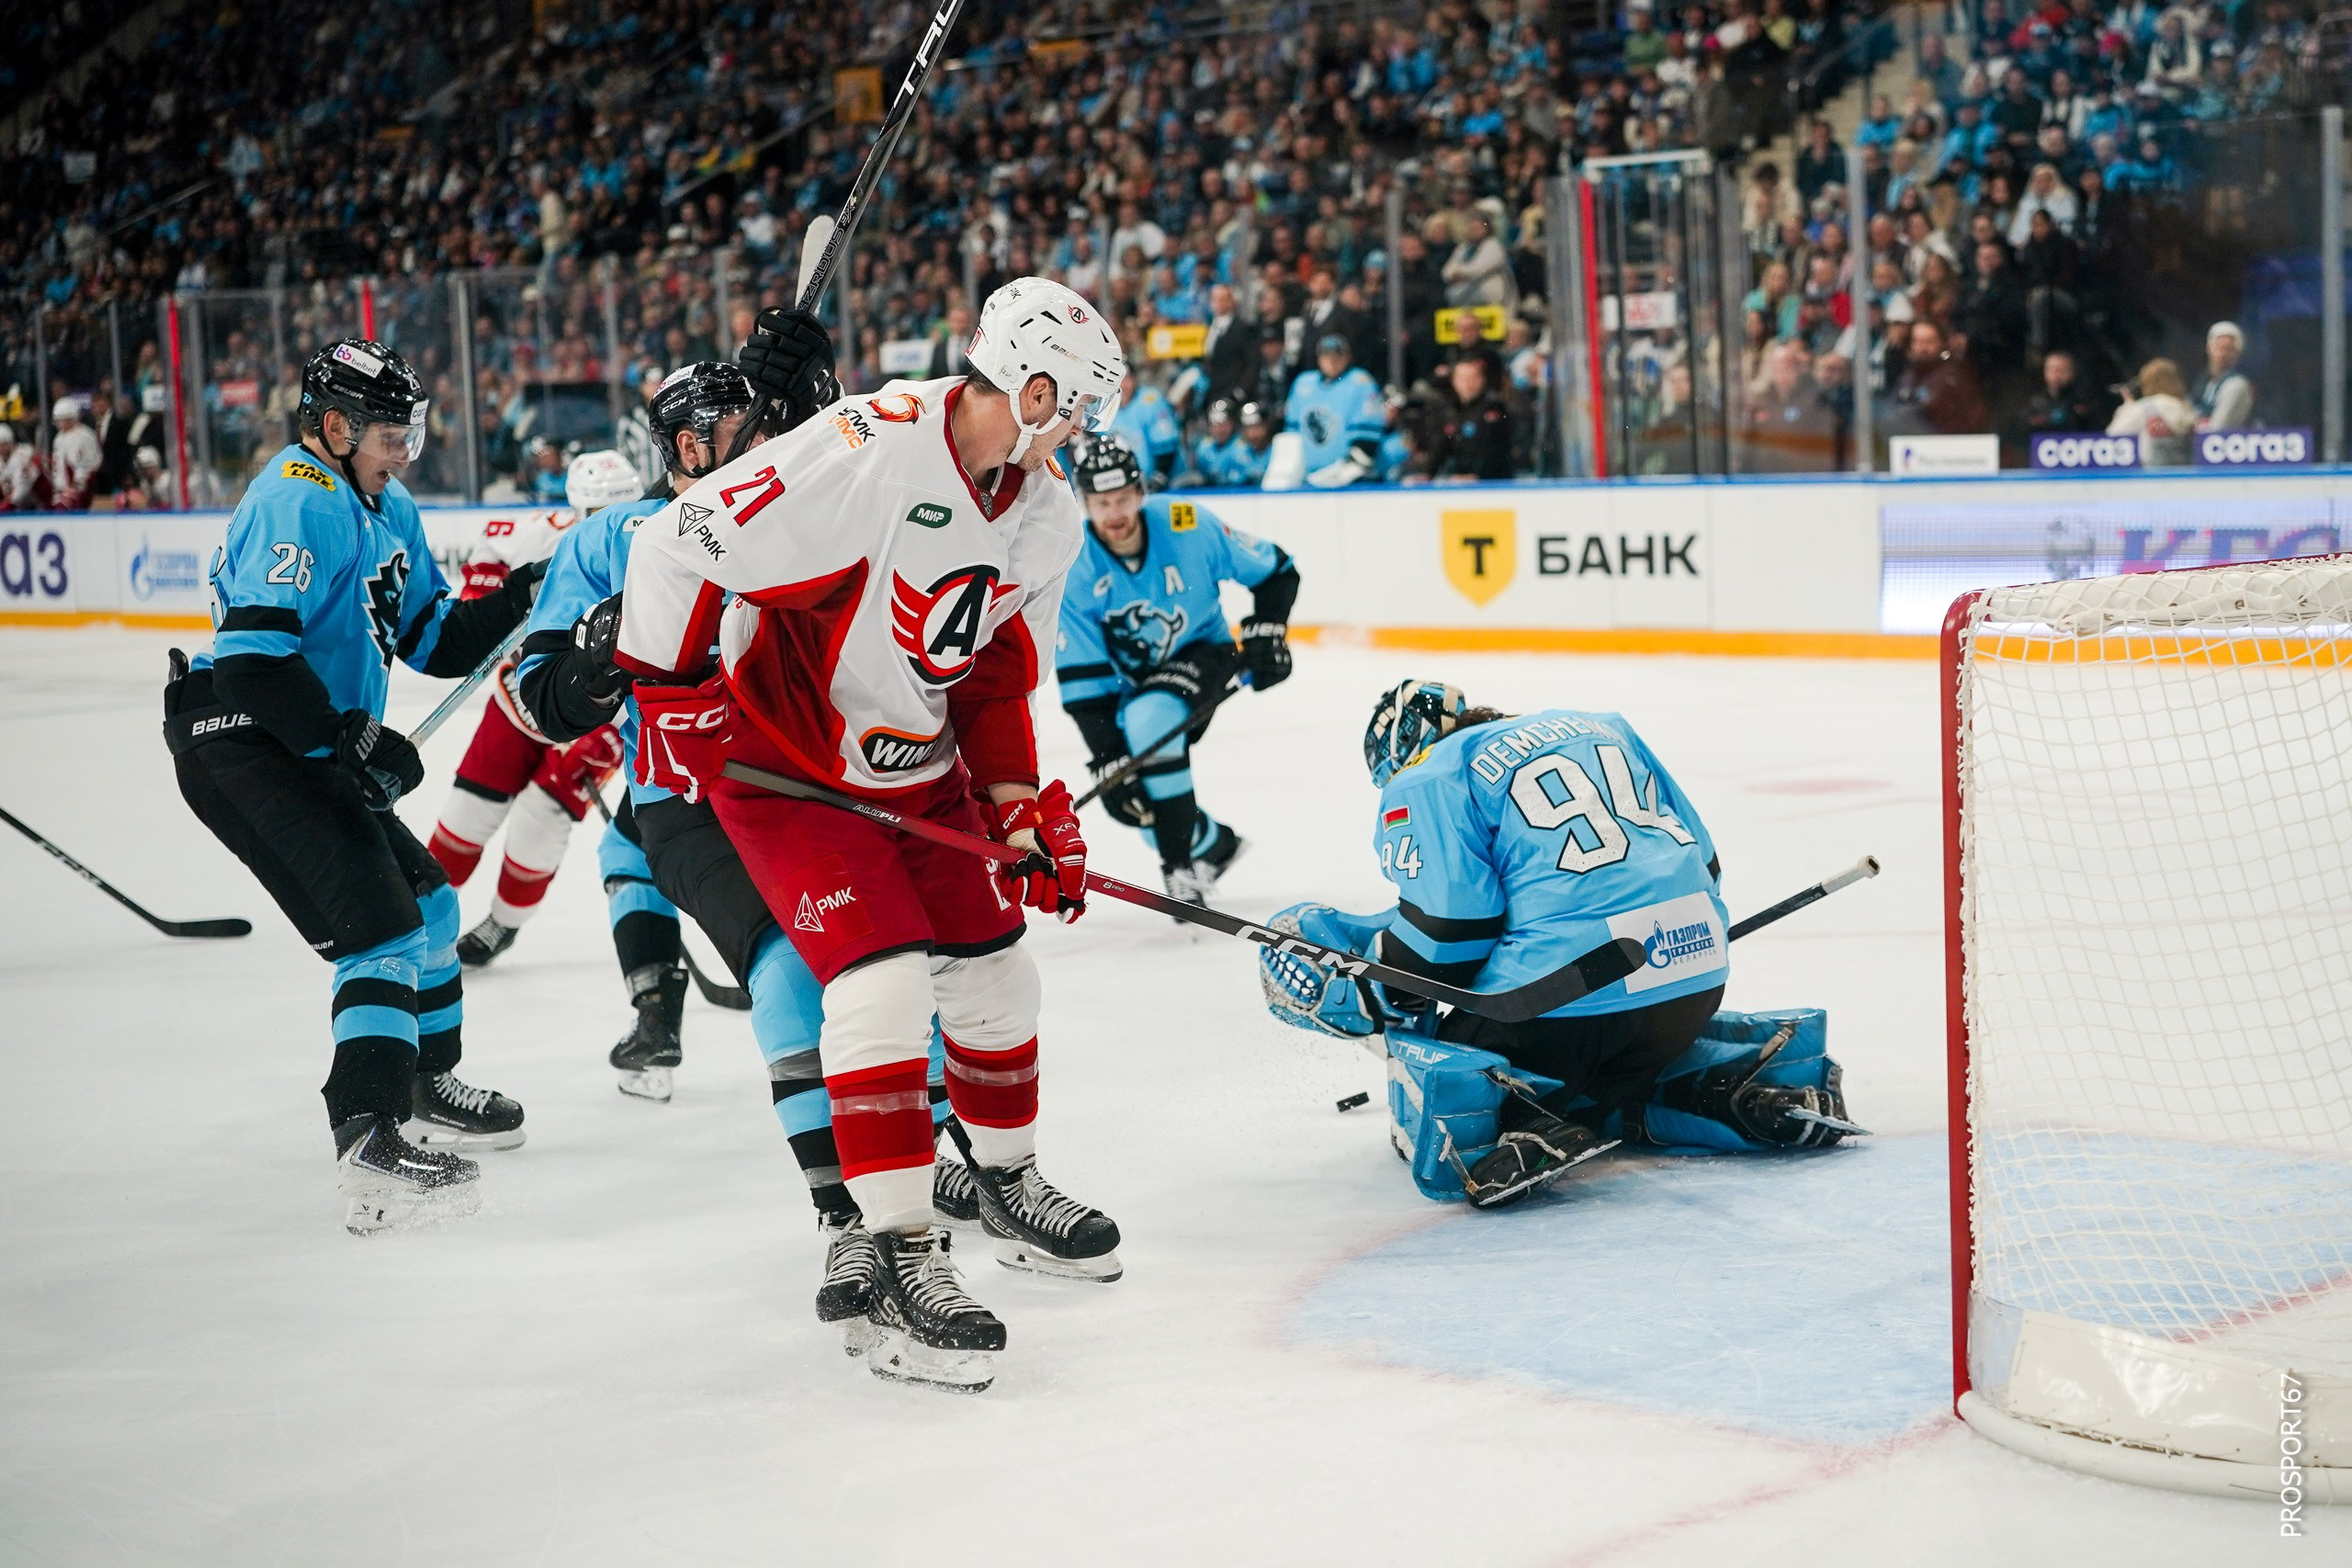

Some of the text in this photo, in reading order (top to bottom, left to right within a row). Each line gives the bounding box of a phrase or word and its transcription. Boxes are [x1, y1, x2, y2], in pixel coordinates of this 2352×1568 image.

[351, 357, 378, 375] belbet
[662, 397, 688, 414] CCM
[289, 461, 328, 479] MAX
[290, 468, 330, 489] LINE
[719, 466, 786, 528] 21
[917, 508, 945, 523] МИР
[694, 525, 727, 561] РМК
[1463, 535, 1699, 576] Т БАНК
[266, 542, 315, 594] 26
[191, 713, 257, 737] BAUE
[656, 703, 730, 731] CC
[1002, 802, 1024, 829] CCM
[1509, 744, 1698, 875] 94
[1381, 834, 1424, 882] 94
[815, 886, 857, 916] РМК
[1666, 920, 1712, 947] ГАЗПРОМ
[1671, 937, 1714, 957] ТРАНСГАЗ
[1235, 924, 1370, 976] CCM
[1672, 949, 1717, 966] БЕЛАРУСЬ
